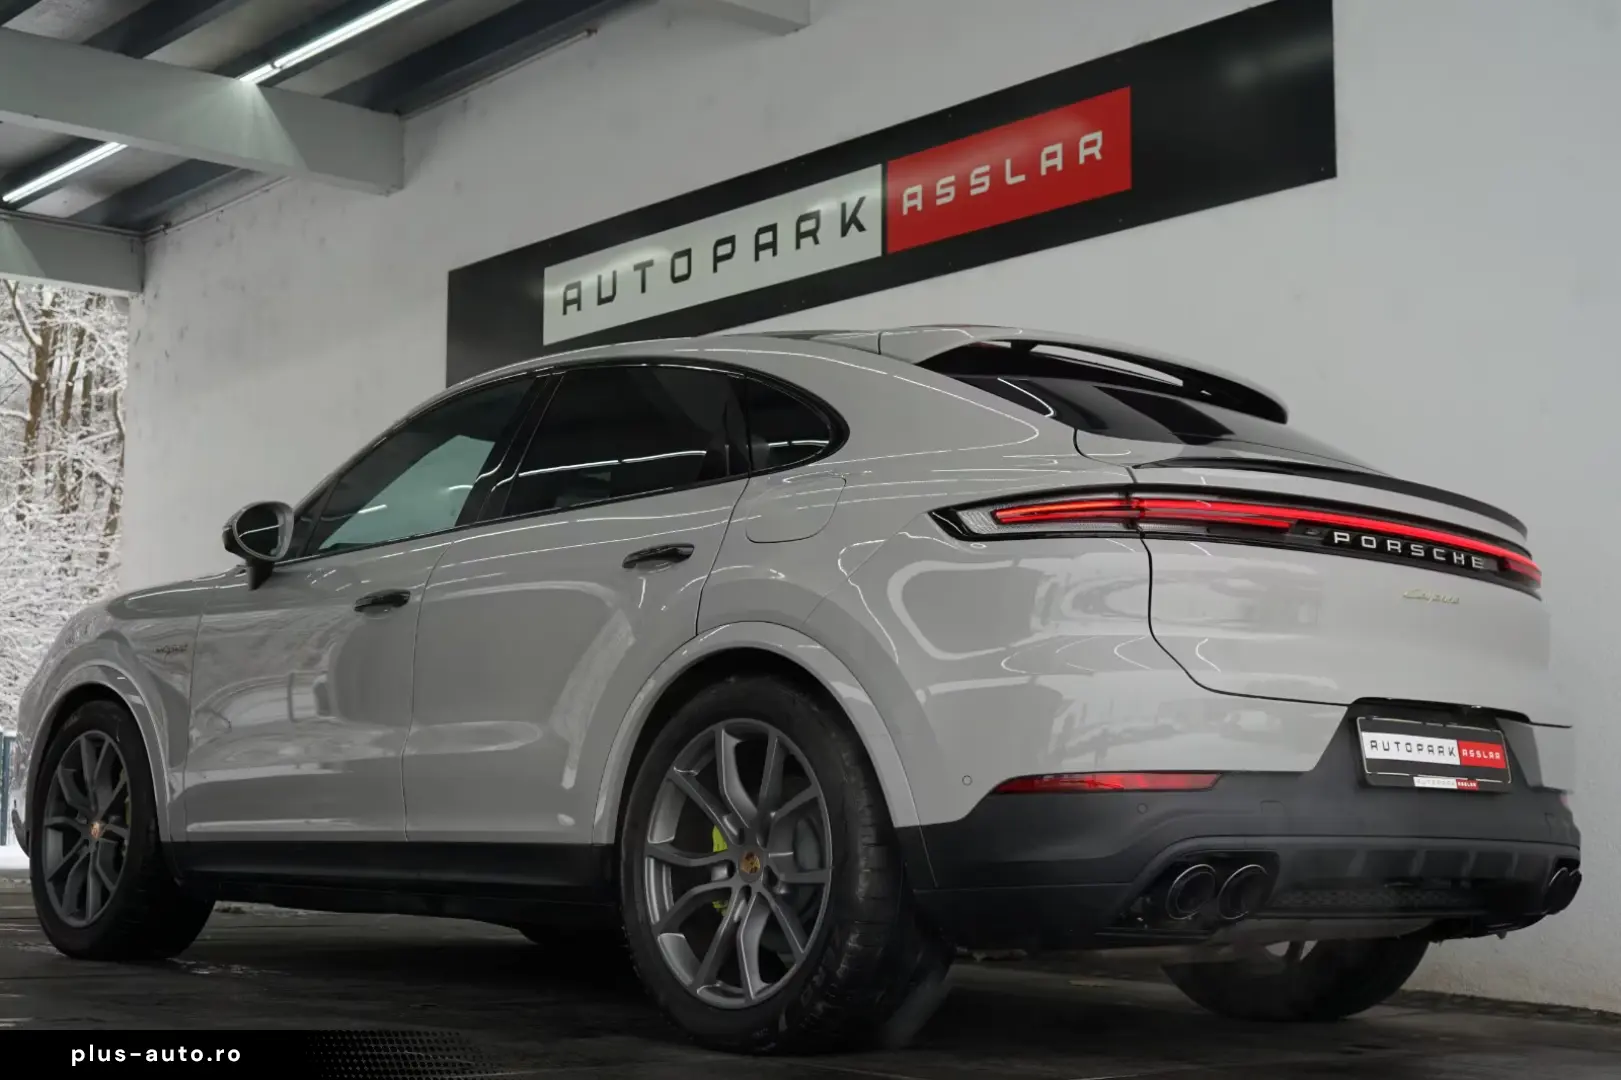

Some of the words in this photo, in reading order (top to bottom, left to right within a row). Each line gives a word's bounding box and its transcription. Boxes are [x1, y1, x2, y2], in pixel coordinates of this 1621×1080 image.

[562, 197, 867, 316] AUTOPARK
[902, 130, 1104, 215] ASSLAR
[1333, 531, 1485, 569] PORSCHE
[1370, 739, 1457, 757] AUTOPARK
[1462, 747, 1501, 760] ASSLAR
